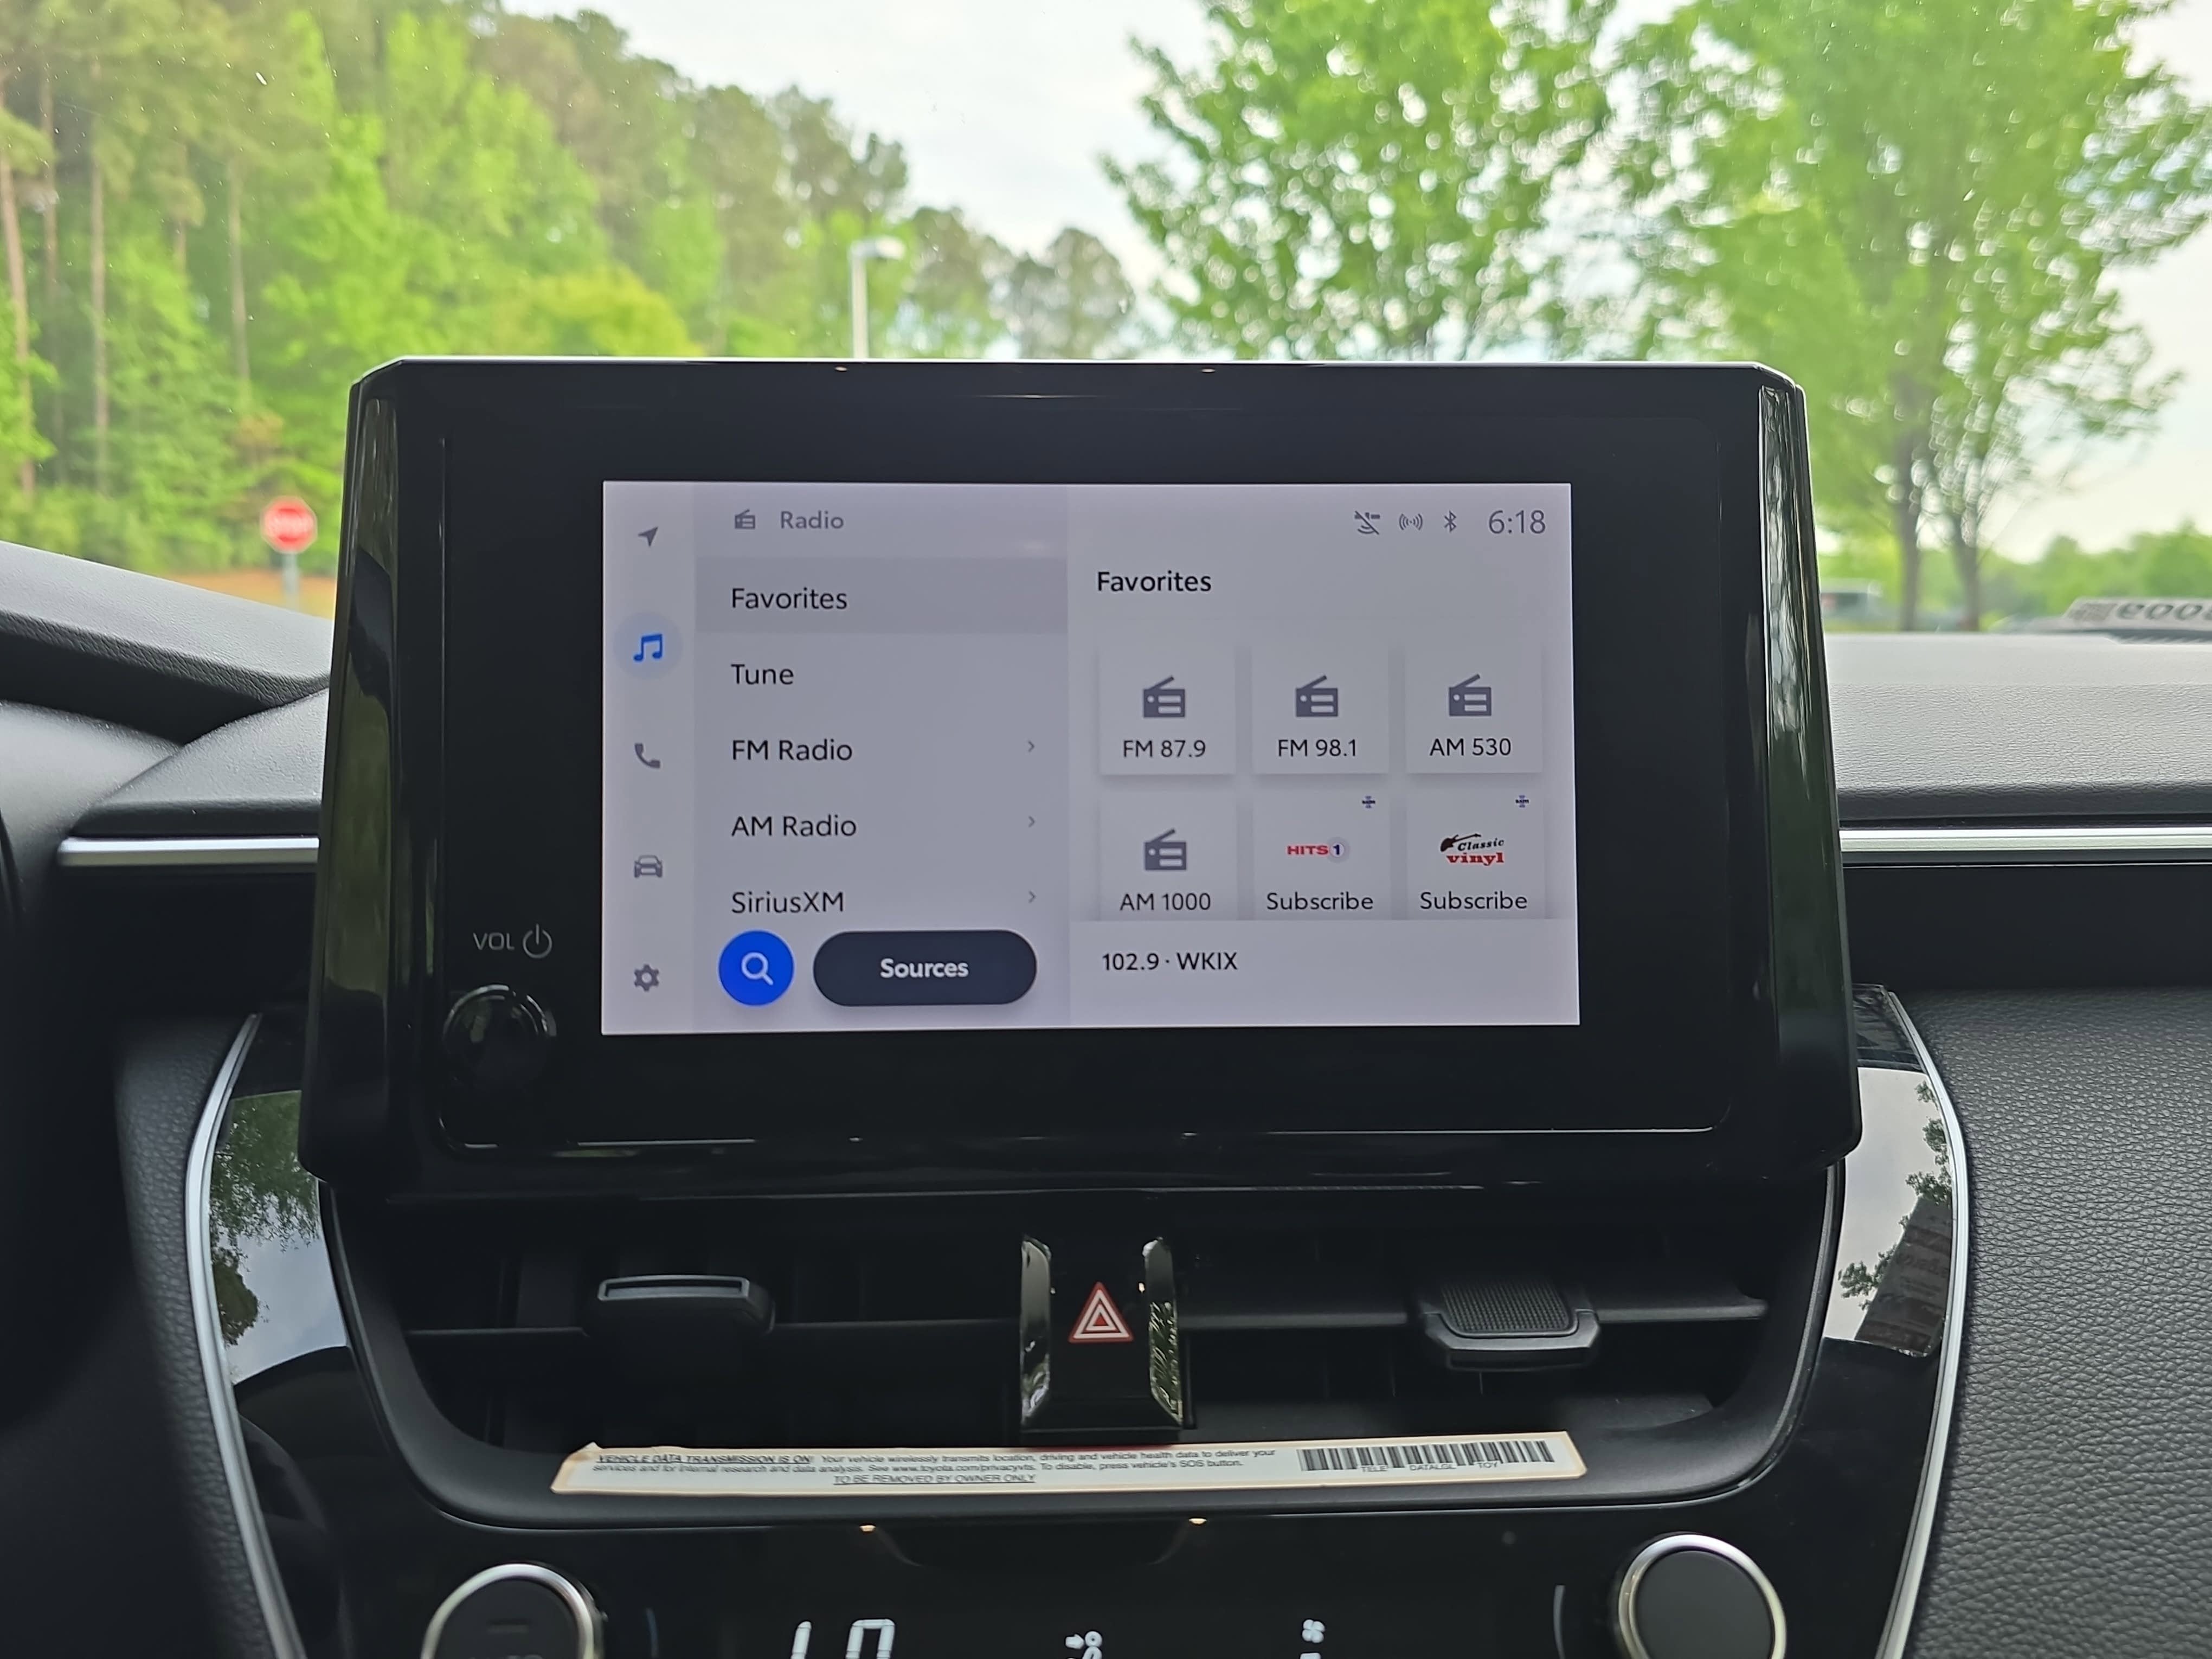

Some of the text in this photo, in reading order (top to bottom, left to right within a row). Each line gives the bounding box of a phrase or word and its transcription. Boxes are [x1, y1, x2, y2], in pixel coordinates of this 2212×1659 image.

[781, 510, 844, 530] Radio
[1488, 510, 1546, 534] 6:18
[1097, 569, 1212, 592] Favorites
[732, 586, 847, 610] Favorites
[730, 663, 794, 685] Tune
[732, 738, 853, 761] FM Radio
[1123, 740, 1206, 758] FM 87.9
[1278, 738, 1356, 757] FM 98.1
[1429, 738, 1512, 756] AM 530
[731, 813, 857, 838] AM Radio
[1287, 845, 1329, 856] HITS
[1457, 838, 1504, 852] Classic
[1446, 852, 1504, 866] vinyl
[731, 890, 844, 914] SiriusXM
[1119, 892, 1211, 911] AM 1000
[1266, 891, 1374, 910] Subscribe
[1420, 890, 1528, 910] Subscribe
[473, 932, 515, 950] VOL
[879, 958, 969, 978] Sources
[1102, 951, 1238, 971] 102.9 WKIX
[888, 1455, 937, 1463] wirelessly
[1040, 1454, 1075, 1462] driving
[1215, 1449, 1249, 1457] deliver
[1252, 1449, 1276, 1458] your
[1099, 1463, 1129, 1471] press
[1179, 1459, 1205, 1468] SOS
[834, 1475, 851, 1483] TO
[853, 1475, 869, 1483] BE
[872, 1474, 934, 1482] REMOVED
[936, 1474, 950, 1482] BY
[1004, 1474, 1036, 1482] ONLY
